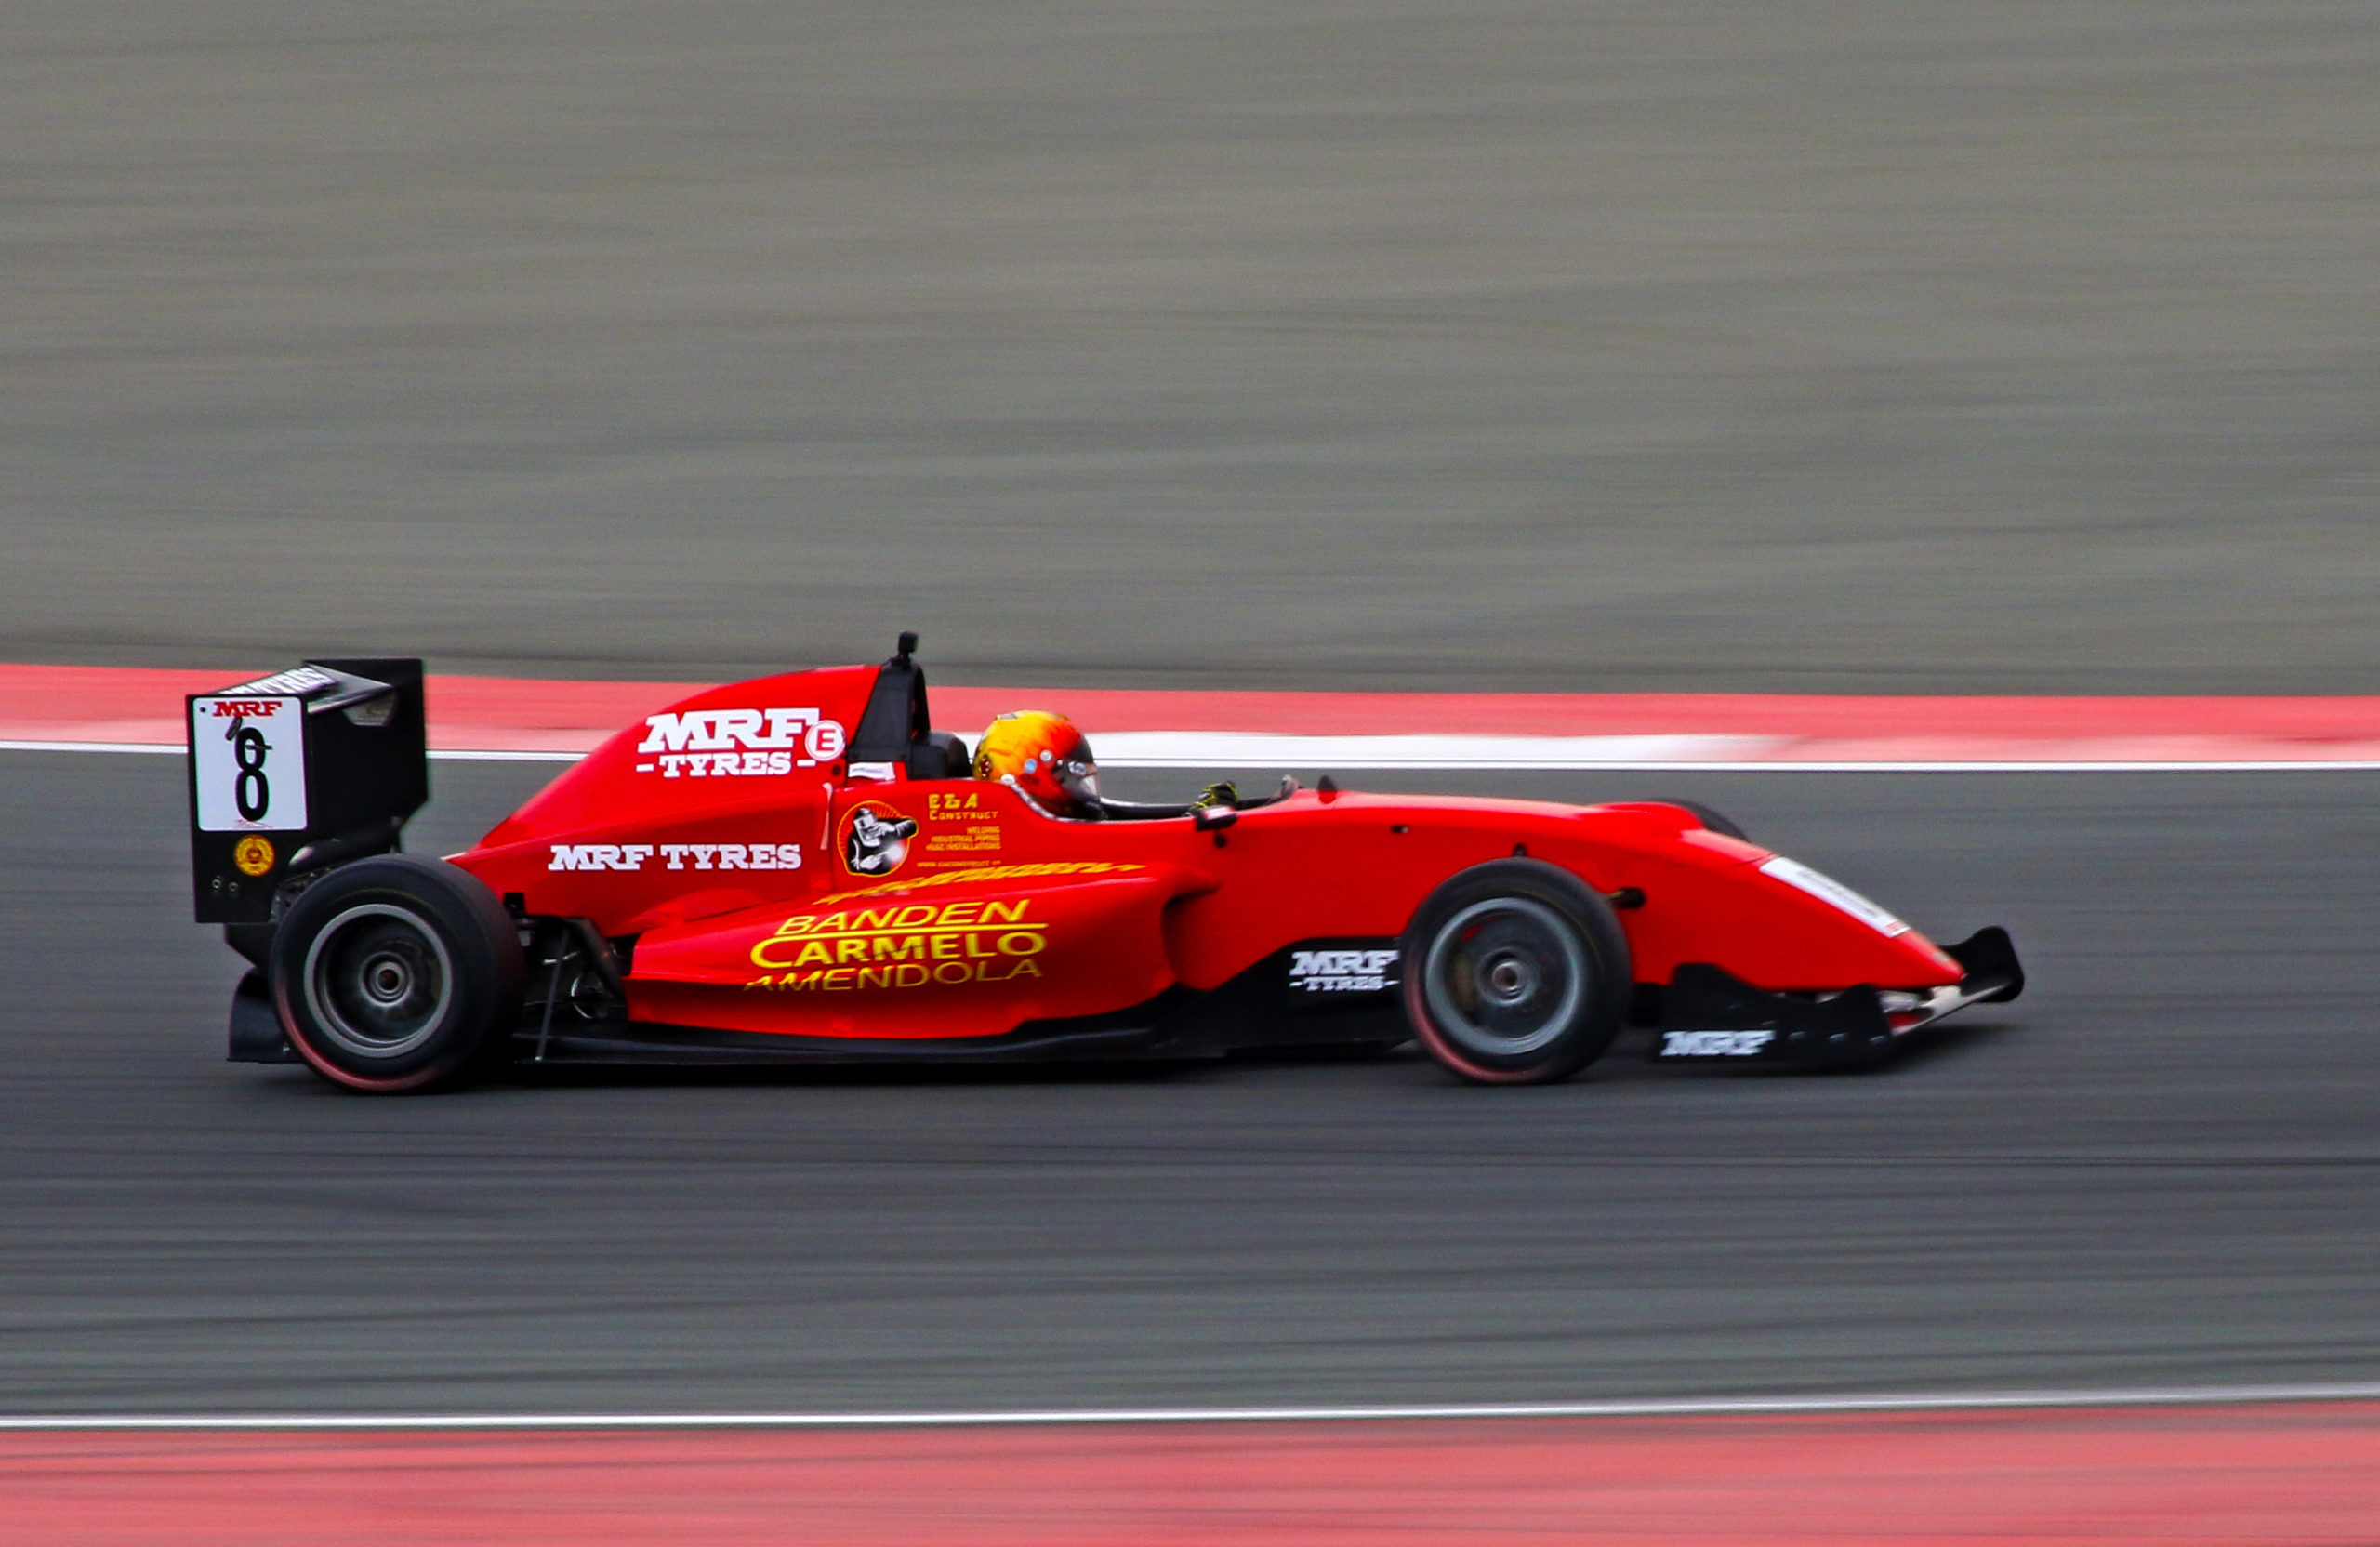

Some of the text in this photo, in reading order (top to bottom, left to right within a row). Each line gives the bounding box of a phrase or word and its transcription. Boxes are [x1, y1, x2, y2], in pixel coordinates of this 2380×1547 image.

[213, 700, 283, 717] MRF
[637, 707, 820, 753] MRF
[234, 727, 270, 822] 8
[658, 751, 792, 778] TYRES
[547, 843, 802, 871] MRF TYRES
[774, 898, 1032, 936] BANDEN
[749, 930, 1048, 970] CARMELO
[1289, 949, 1400, 976] MRF
[744, 958, 1044, 992] AMENDOLA
[1660, 1030, 1777, 1056] MRF
